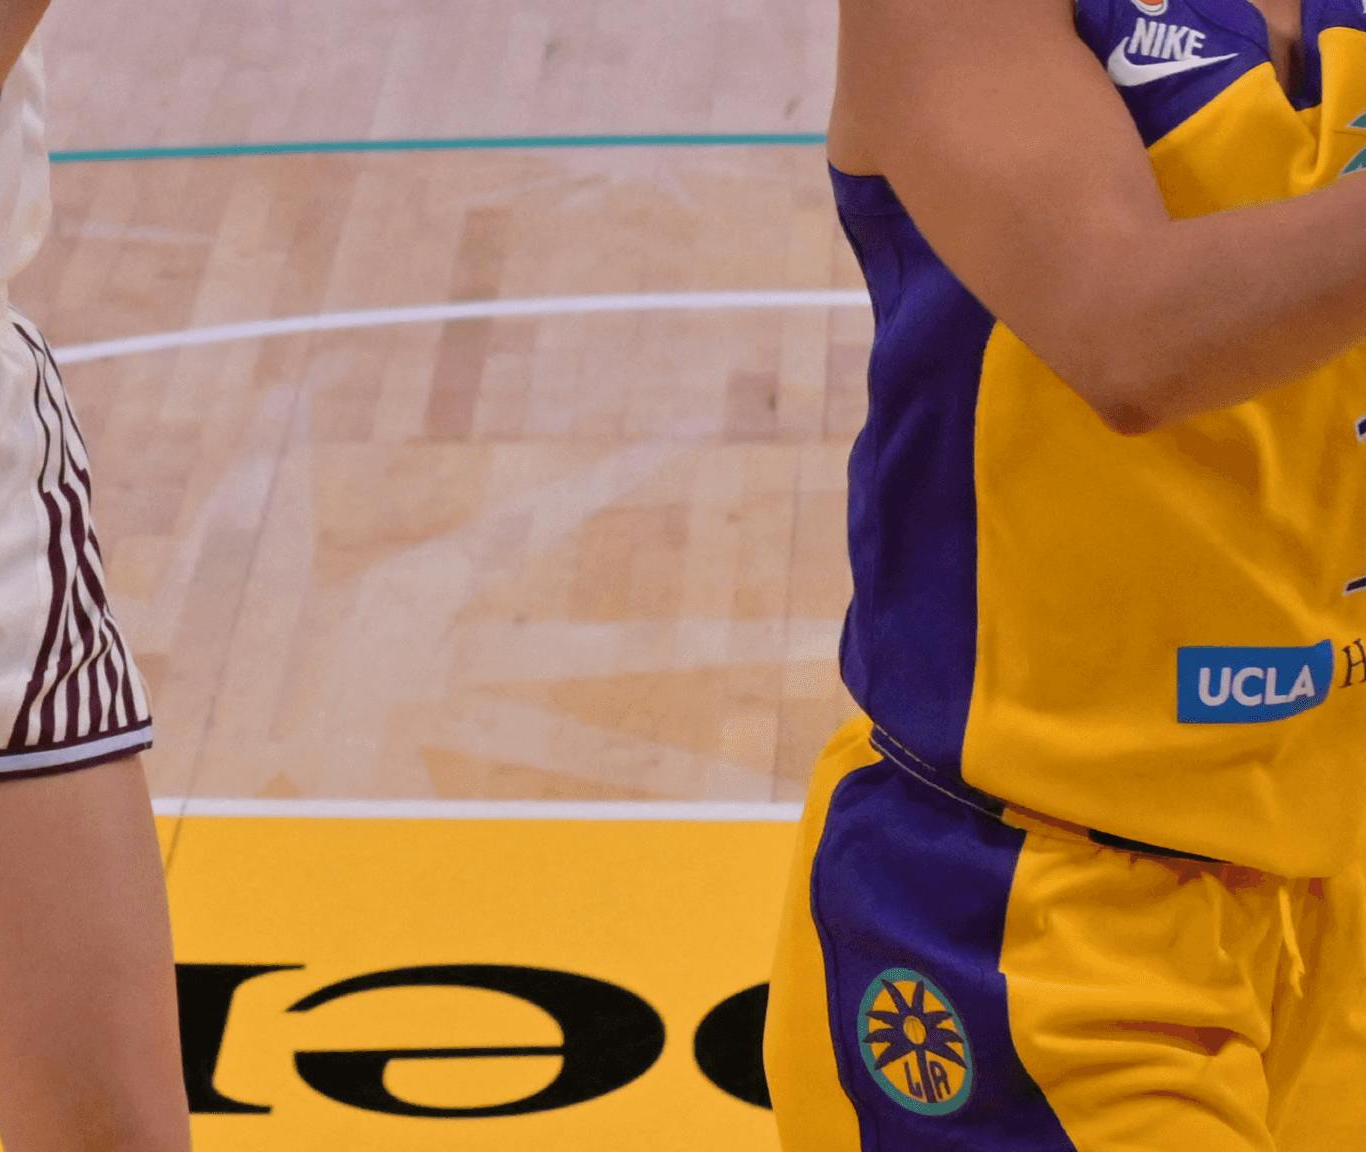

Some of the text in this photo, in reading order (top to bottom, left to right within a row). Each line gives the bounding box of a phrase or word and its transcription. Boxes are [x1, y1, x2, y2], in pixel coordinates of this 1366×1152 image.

[1125, 17, 1207, 61] NIKE
[1197, 663, 1317, 707] UCLA
[903, 1059, 952, 1101] LA
